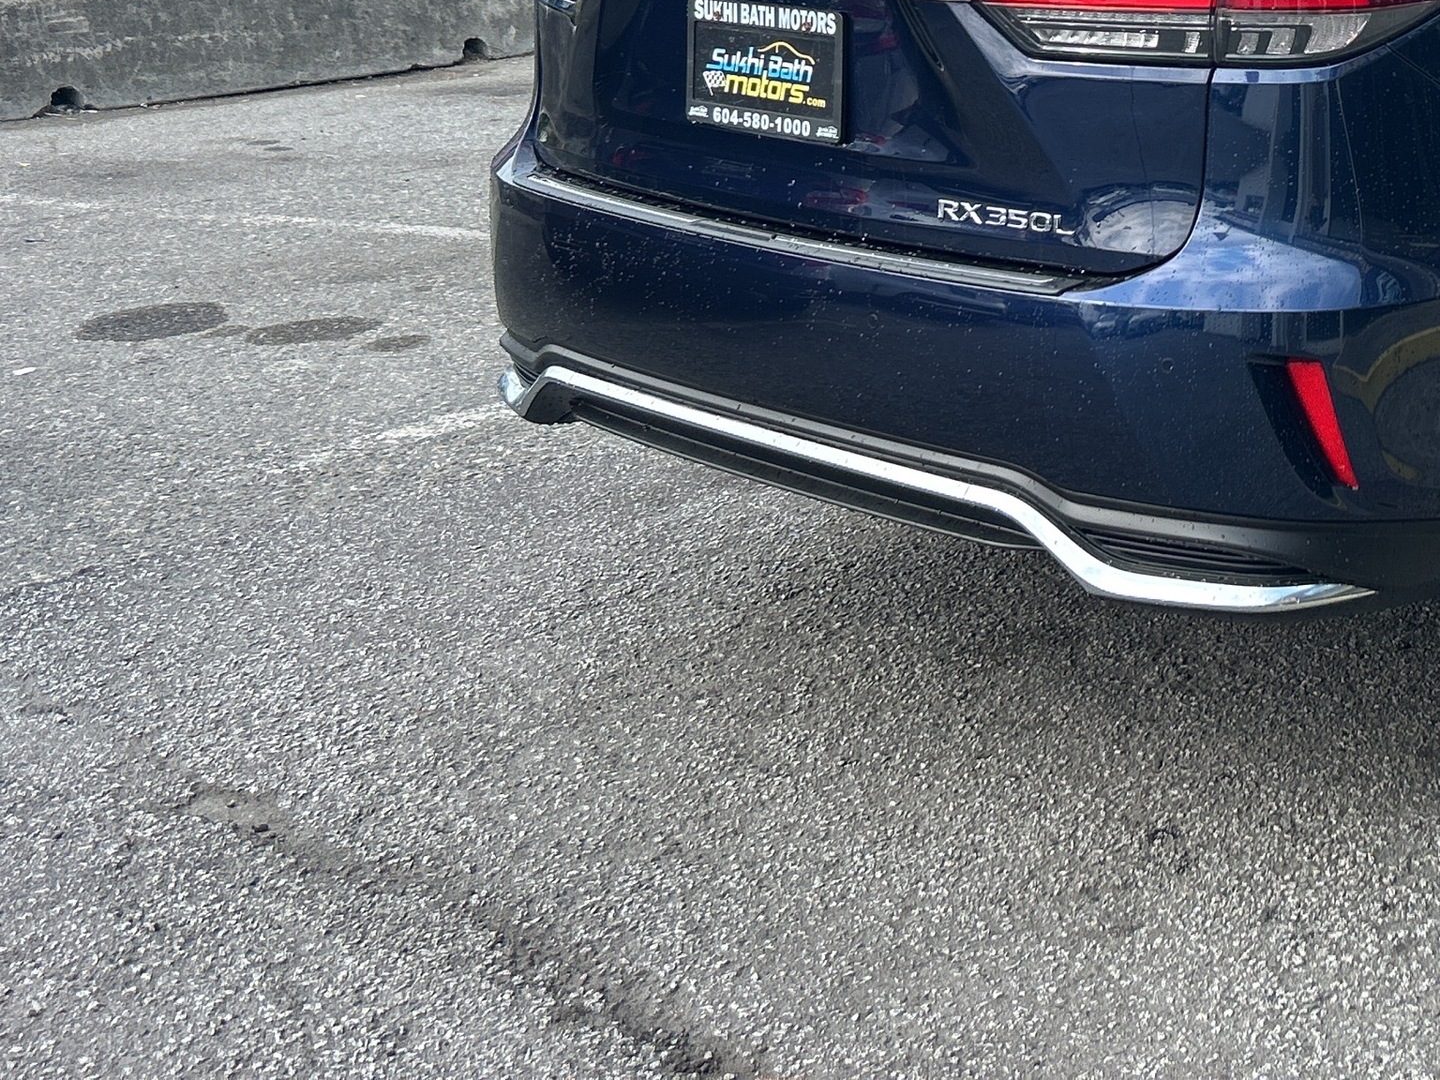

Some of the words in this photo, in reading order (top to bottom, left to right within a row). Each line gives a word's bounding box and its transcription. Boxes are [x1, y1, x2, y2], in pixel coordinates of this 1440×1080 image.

[741, 3, 775, 28] BATH
[778, 7, 837, 35] MOTORS
[706, 47, 765, 76] Sukhi
[768, 55, 814, 83] Bath
[713, 107, 811, 137] 604-580-1000
